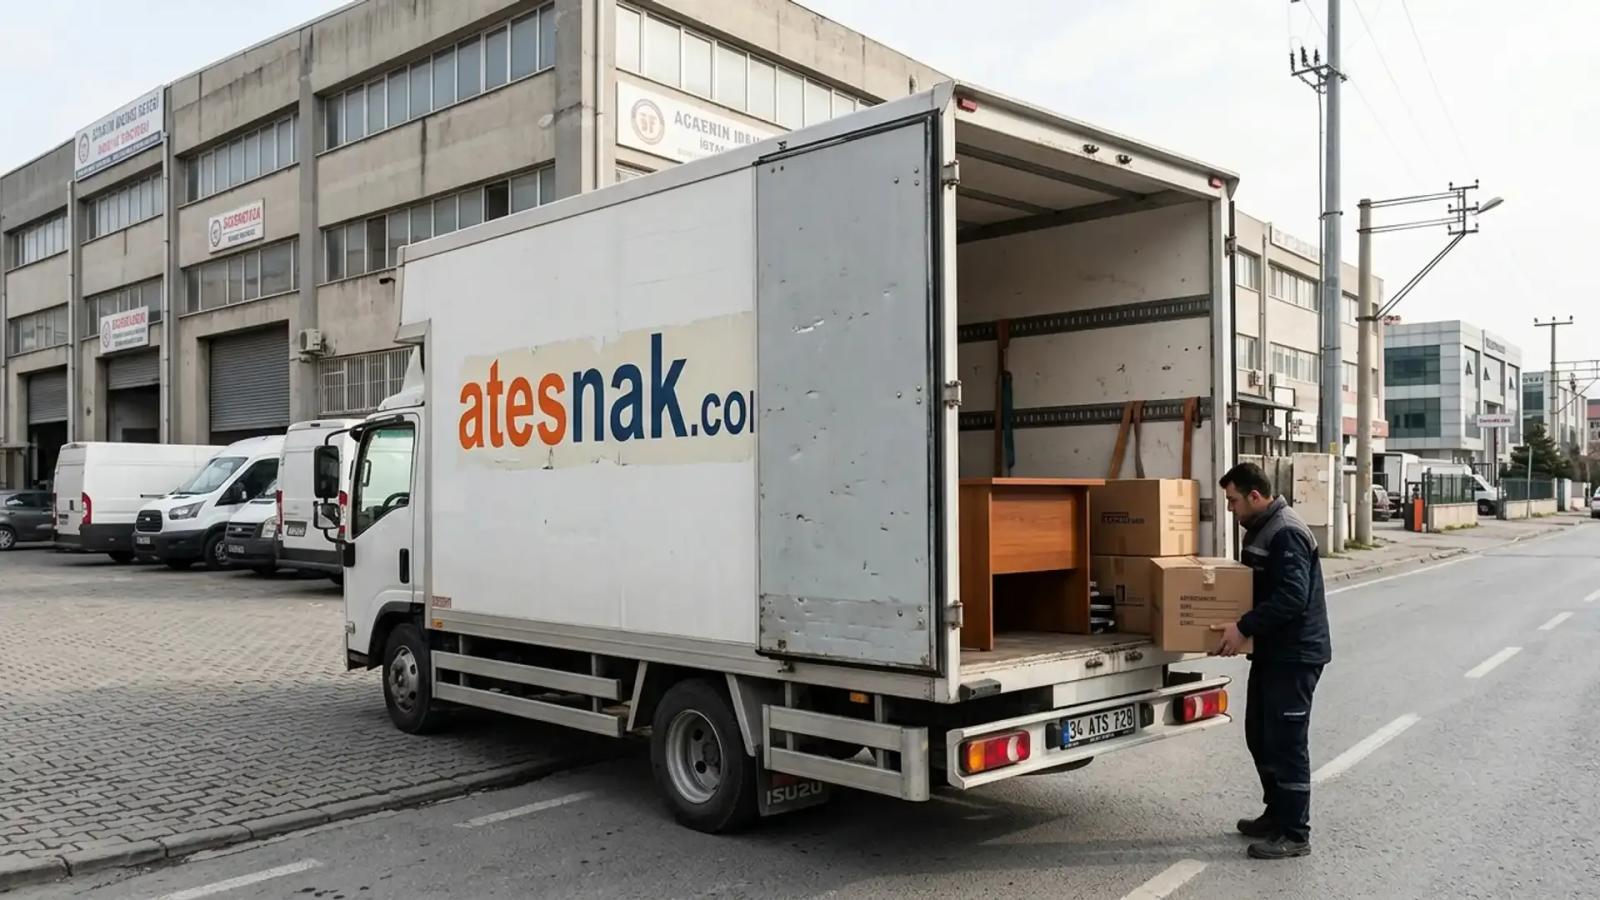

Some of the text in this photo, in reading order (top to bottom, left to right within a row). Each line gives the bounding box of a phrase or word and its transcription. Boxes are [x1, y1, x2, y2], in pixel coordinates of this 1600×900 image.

[459, 333, 754, 450] atesnak.co
[1089, 714, 1108, 734] ATS
[766, 782, 823, 806] ISUZU
